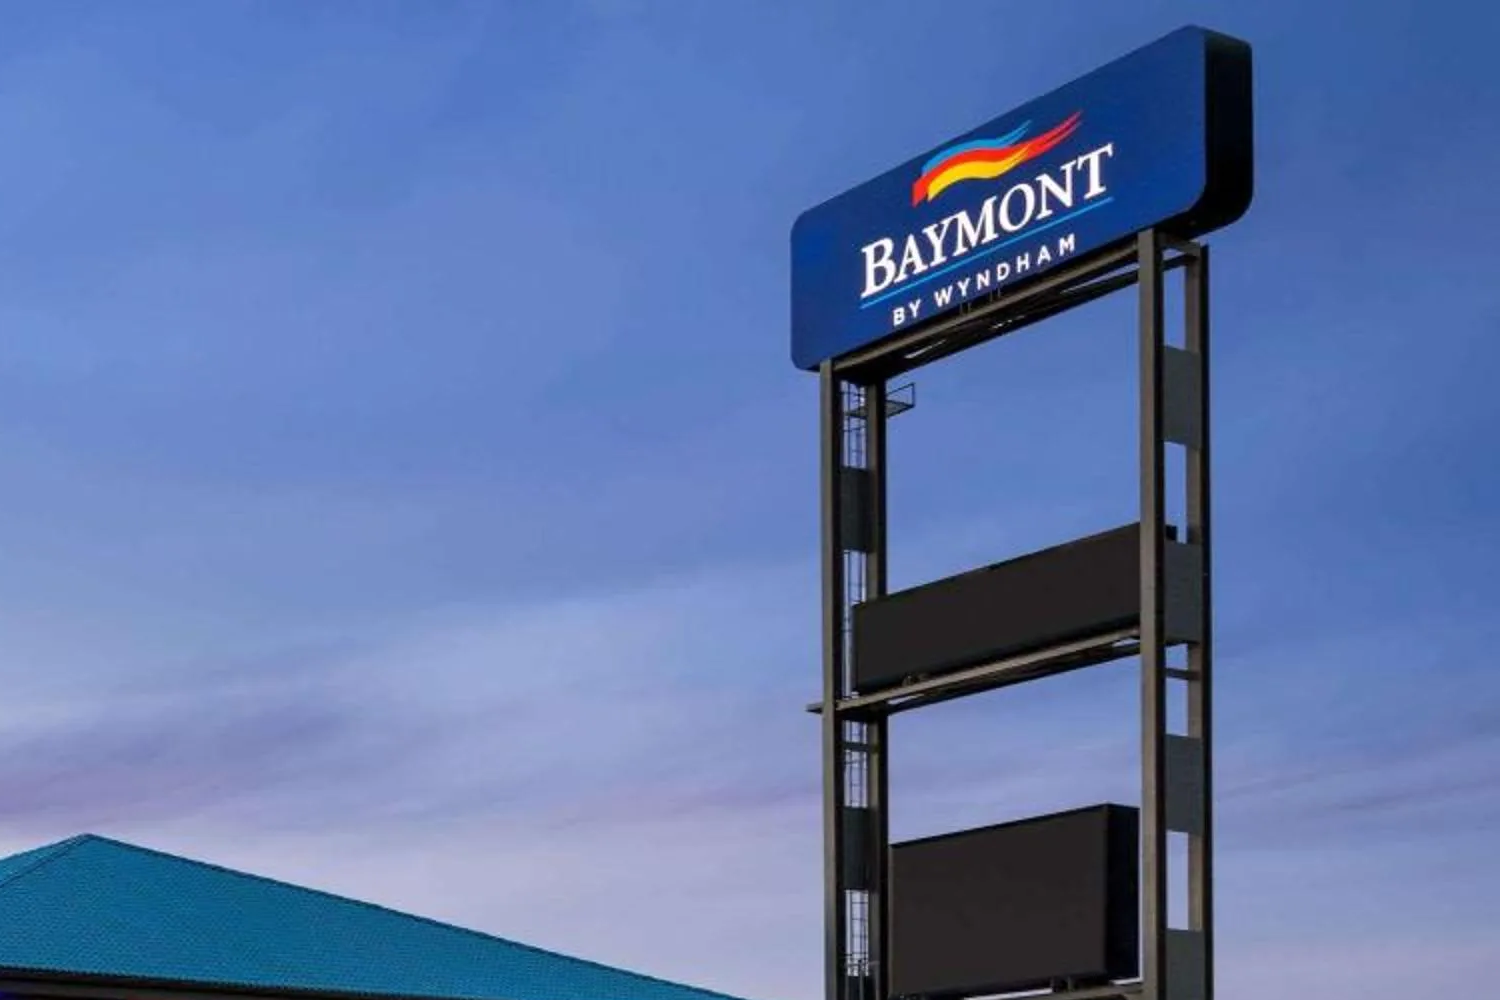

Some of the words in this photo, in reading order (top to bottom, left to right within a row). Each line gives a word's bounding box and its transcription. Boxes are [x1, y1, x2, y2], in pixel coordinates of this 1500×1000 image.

[860, 143, 1113, 298] BAYMONT
[893, 298, 921, 327] BY
[934, 232, 1077, 307] WYNDHAM
